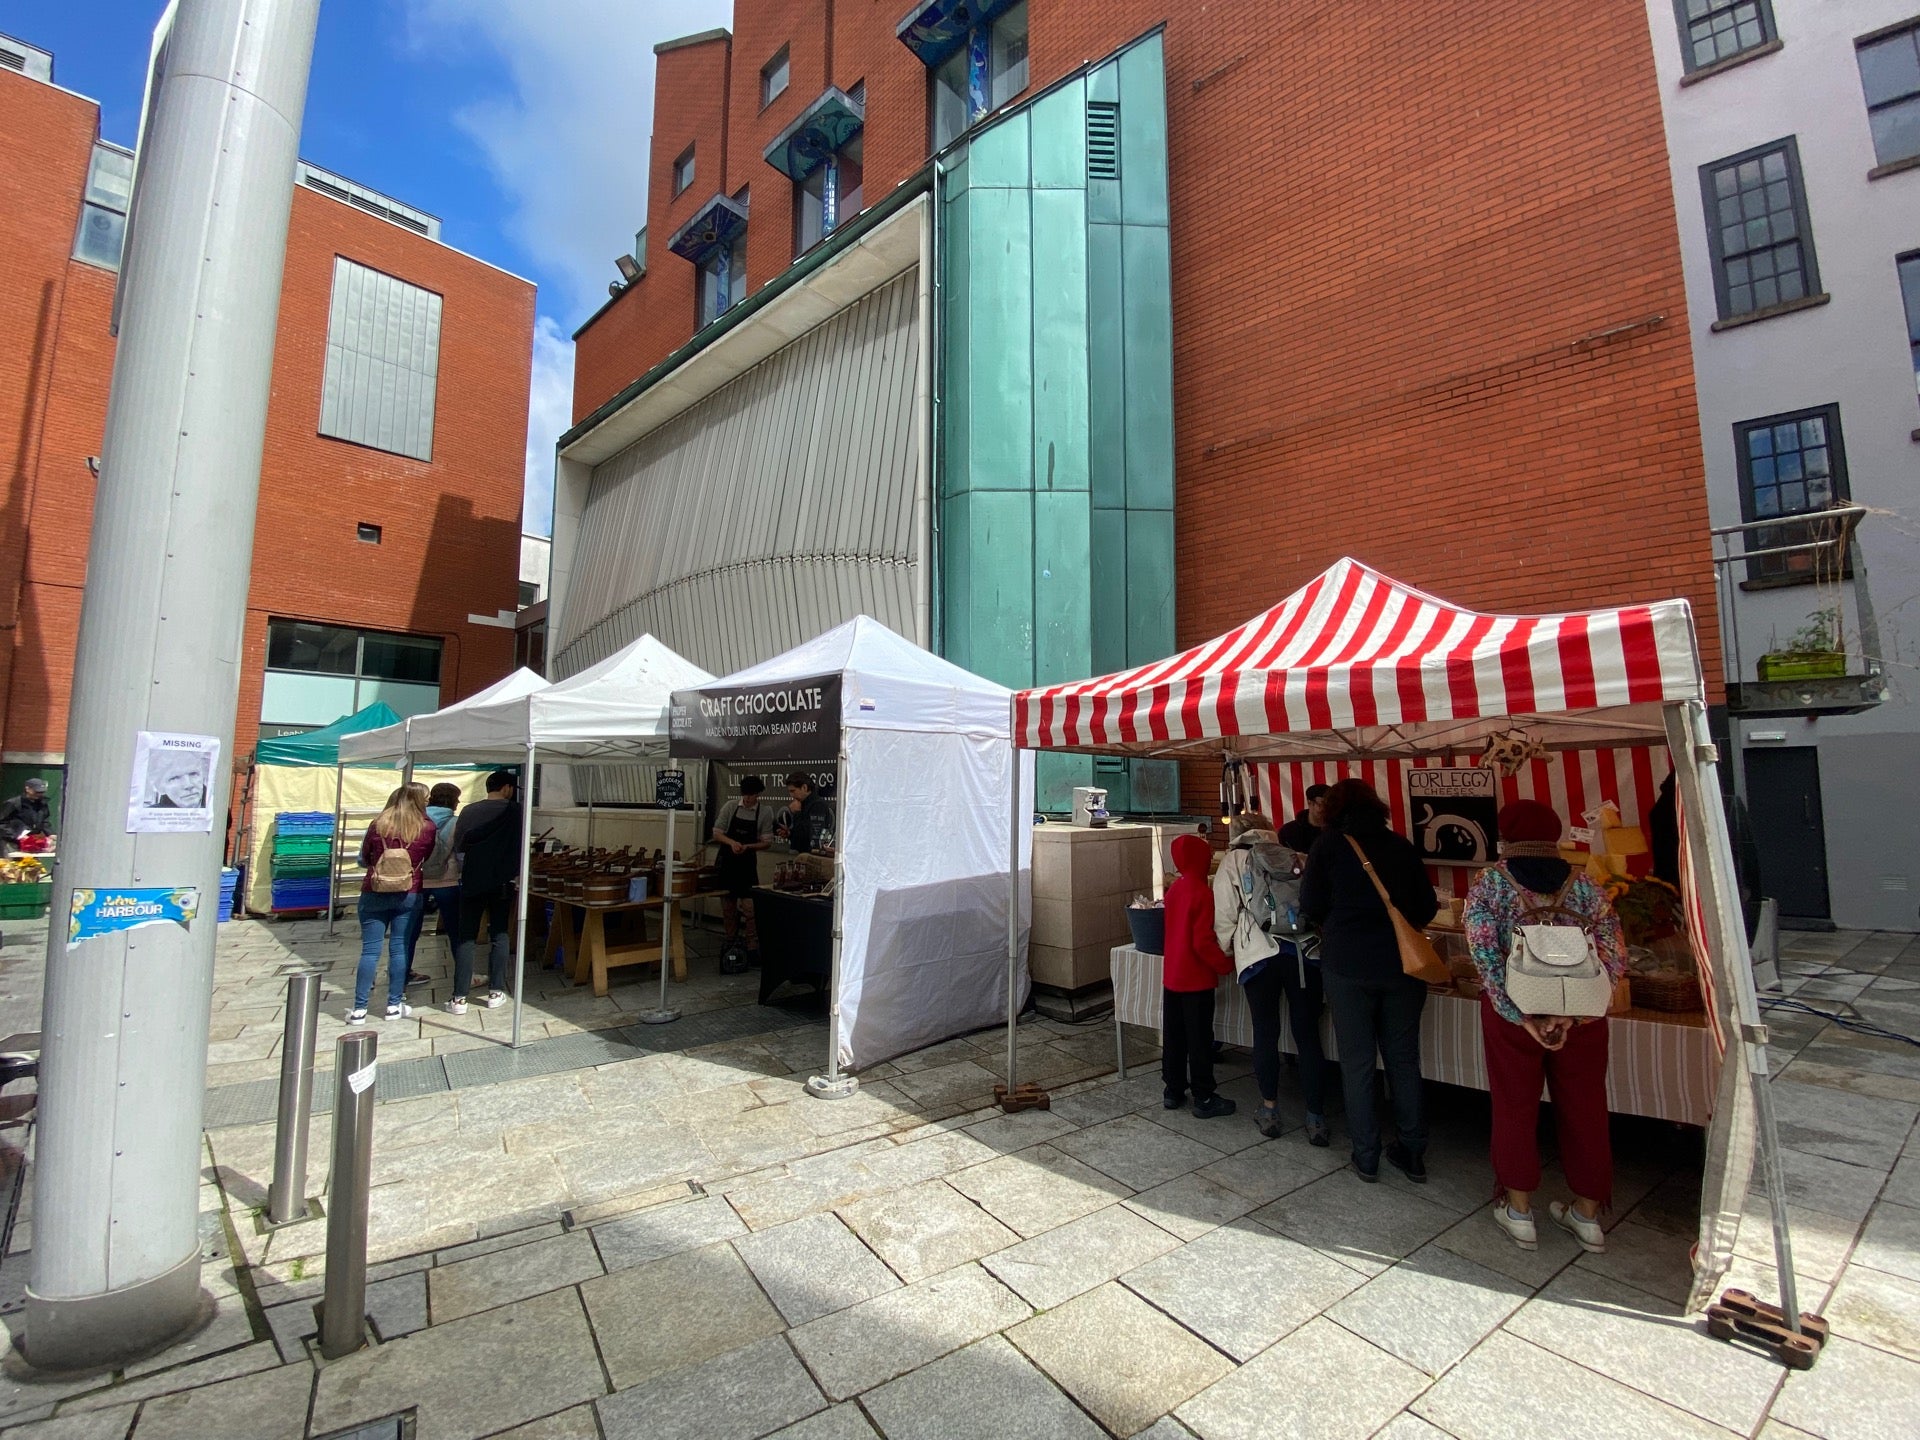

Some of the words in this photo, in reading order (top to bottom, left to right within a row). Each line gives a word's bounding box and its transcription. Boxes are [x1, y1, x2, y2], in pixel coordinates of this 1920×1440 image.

[700, 696, 732, 717] CRAFT
[734, 688, 822, 716] CHOCOLATE
[727, 726, 748, 737] DUBLIN
[749, 724, 770, 736] FROM
[771, 723, 790, 735] BEAN
[791, 722, 801, 734] TO
[802, 721, 817, 733] BAR
[162, 739, 202, 749] MISSING
[1410, 772, 1490, 788] CORLEGGY
[1424, 787, 1474, 796] CHEESES
[95, 904, 163, 918] HARBOUR
